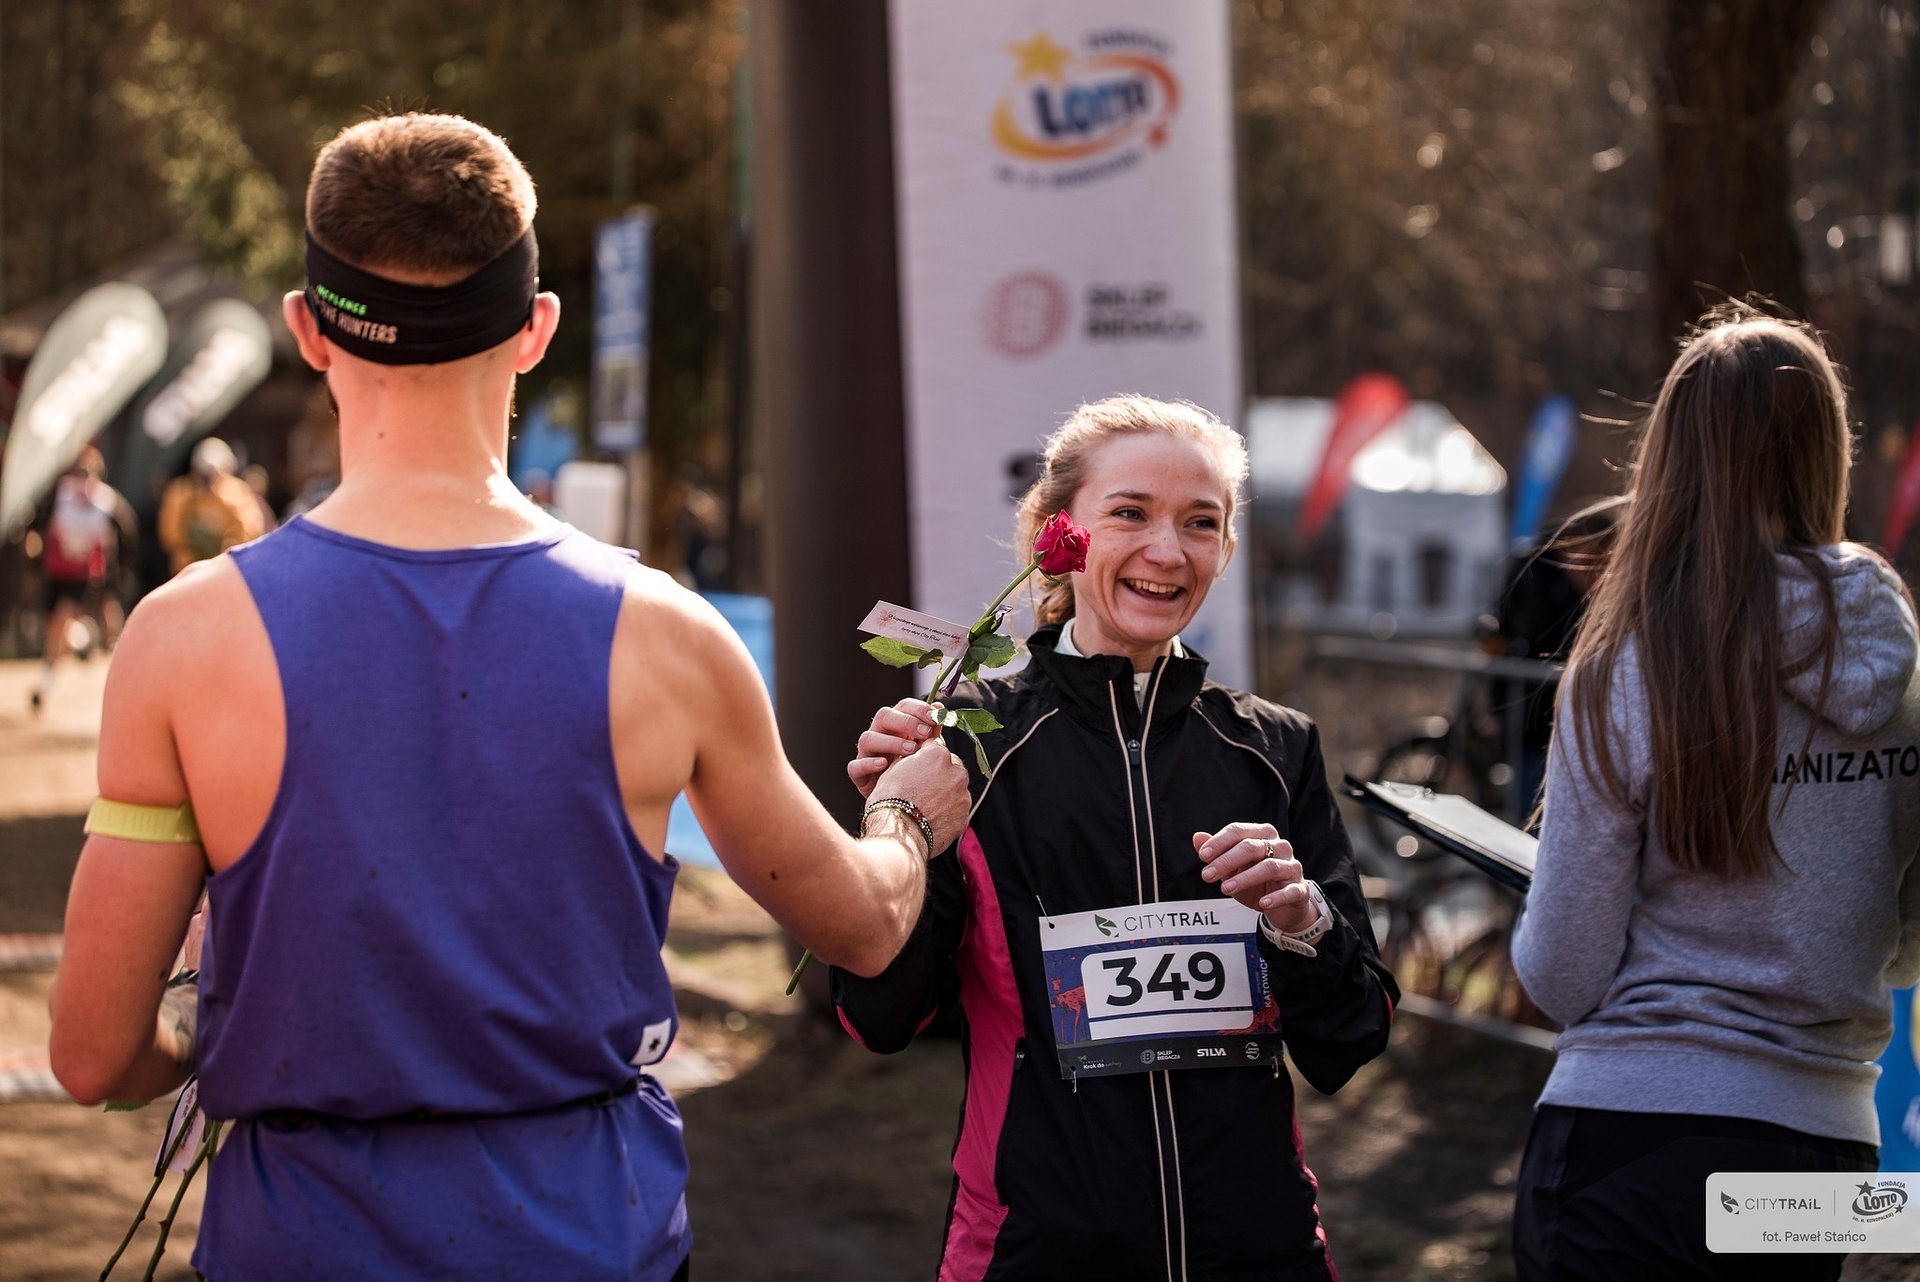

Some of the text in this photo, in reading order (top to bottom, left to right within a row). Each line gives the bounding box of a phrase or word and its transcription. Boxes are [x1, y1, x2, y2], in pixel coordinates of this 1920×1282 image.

[1772, 745, 1920, 785] ANIZATO
[1102, 951, 1226, 1007] 349
[1196, 1048, 1227, 1057] SILVA
